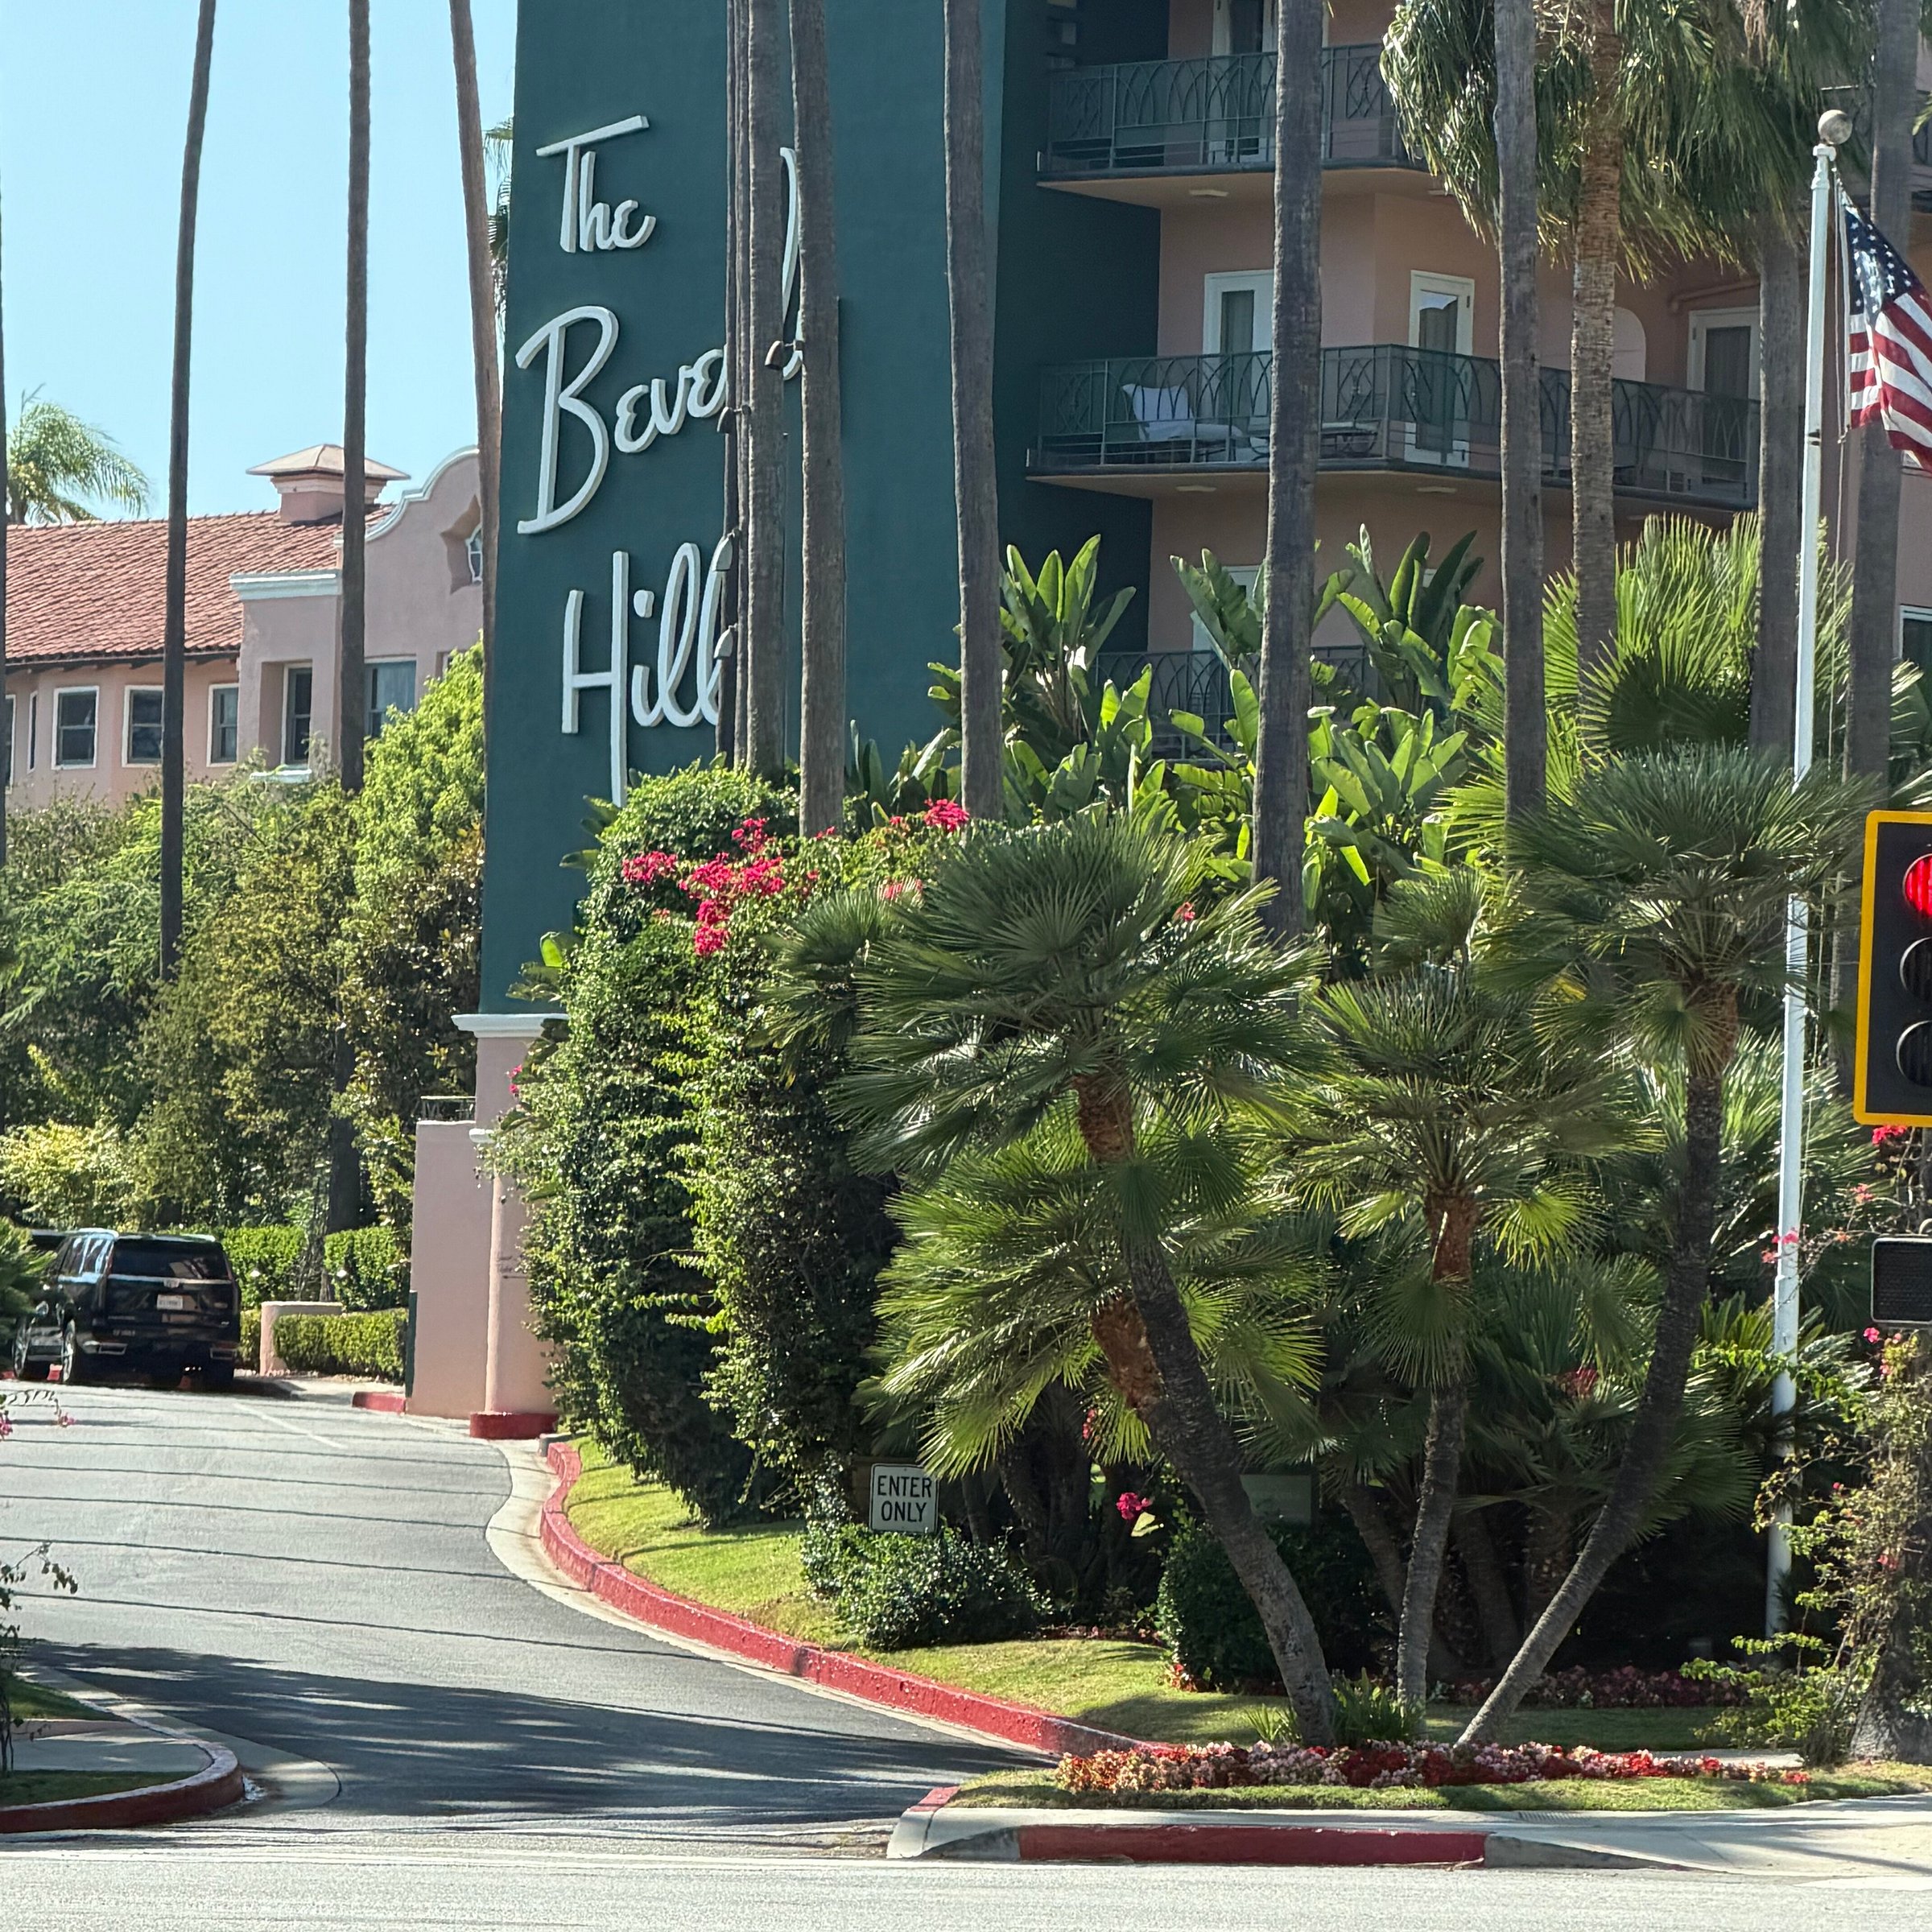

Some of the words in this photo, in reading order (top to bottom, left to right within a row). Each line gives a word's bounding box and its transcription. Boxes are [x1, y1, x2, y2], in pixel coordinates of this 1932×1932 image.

[535, 114, 657, 254] The
[514, 146, 804, 535] Bevel
[561, 535, 729, 807] Hill
[877, 1475, 931, 1498] ENTER
[881, 1500, 927, 1522] ONLY
